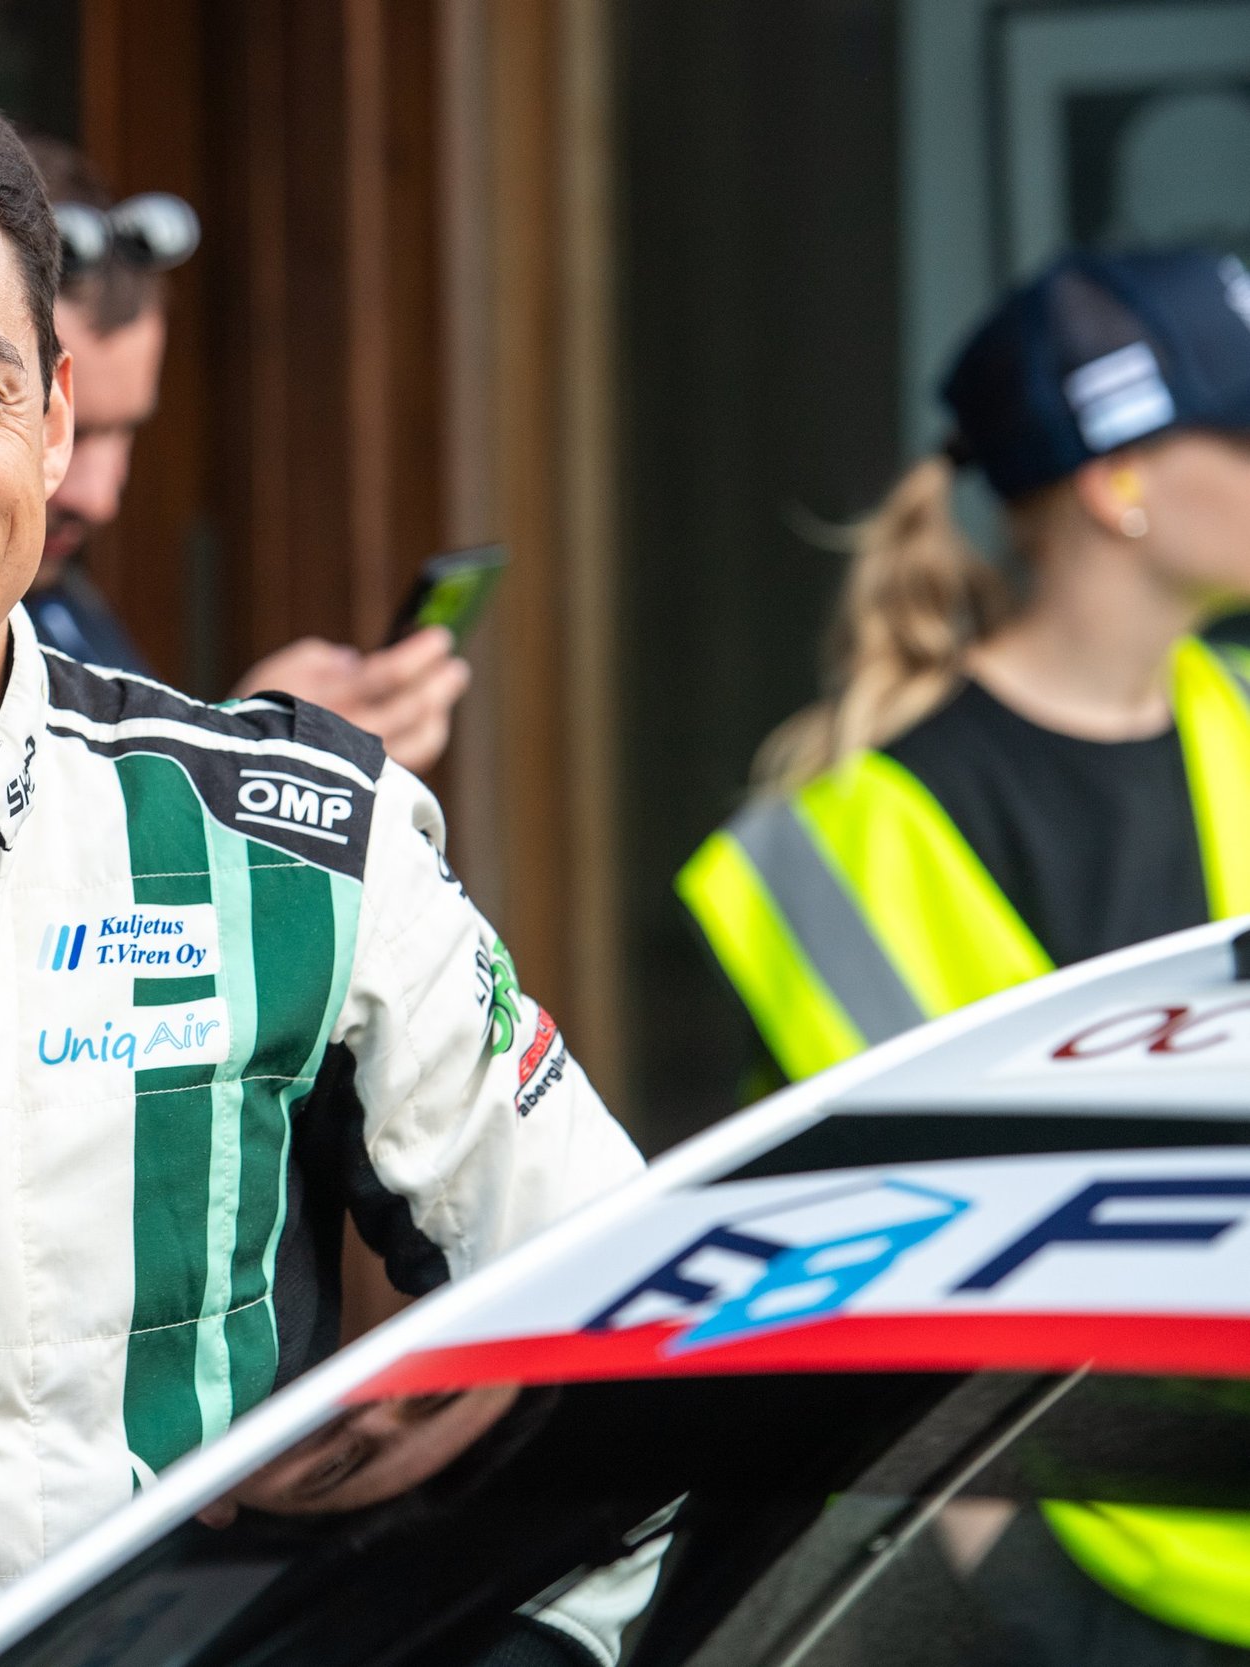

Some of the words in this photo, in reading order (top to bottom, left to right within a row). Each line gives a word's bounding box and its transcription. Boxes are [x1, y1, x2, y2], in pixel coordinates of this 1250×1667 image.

[238, 779, 353, 829] OMP
[99, 914, 184, 939] Kuljetus
[97, 943, 170, 965] T.Viren
[176, 943, 207, 968] Oy
[38, 1021, 137, 1069] Uniq
[144, 1013, 221, 1054] Air
